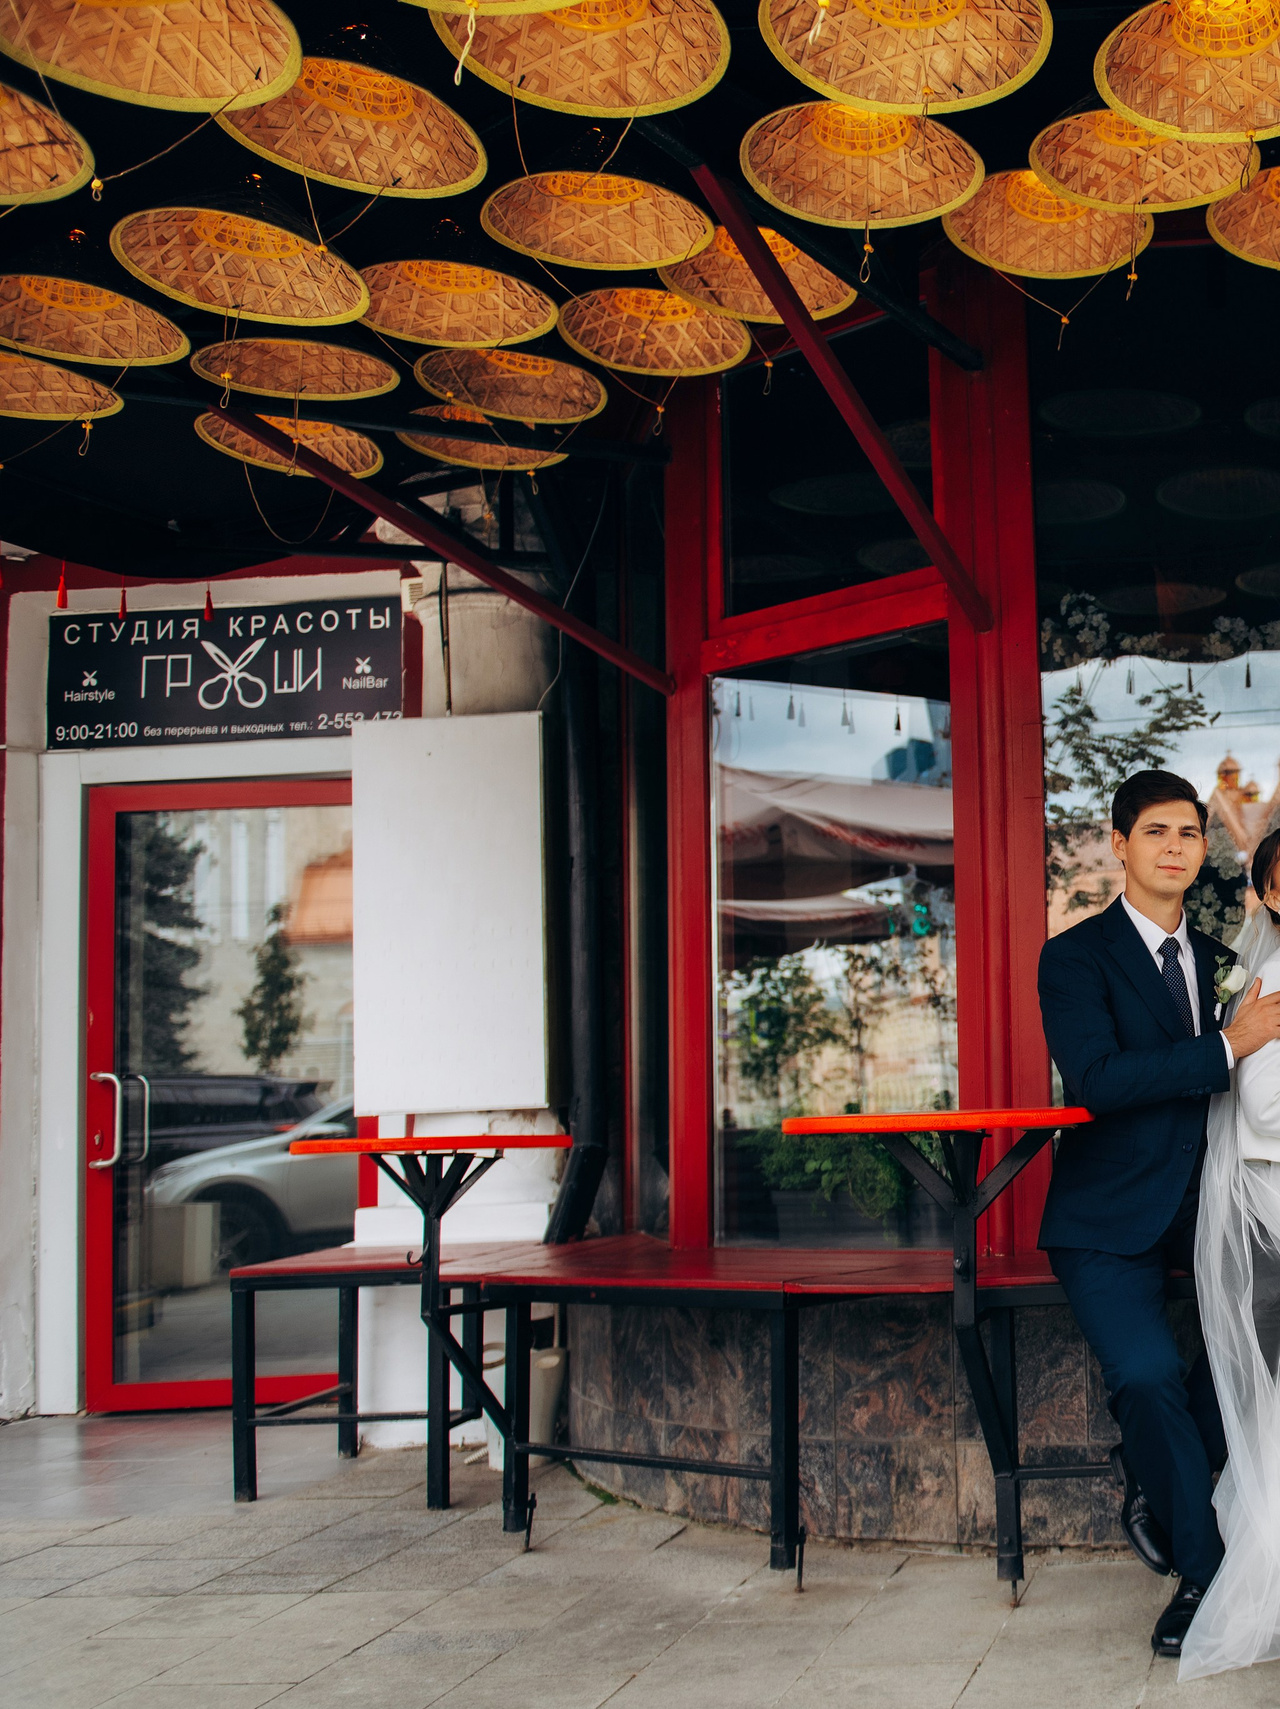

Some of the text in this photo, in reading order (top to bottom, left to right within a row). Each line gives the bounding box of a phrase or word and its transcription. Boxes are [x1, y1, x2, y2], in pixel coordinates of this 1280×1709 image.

[63, 607, 391, 646] СТУДИЯ КРАСОТЫ
[342, 675, 389, 690] NailBar
[64, 688, 116, 703] Hairstyle
[55, 721, 139, 742] 9:00-21:00
[143, 725, 162, 737] без
[164, 725, 218, 738] перерыва
[220, 725, 228, 734] и
[230, 722, 284, 735] выходных
